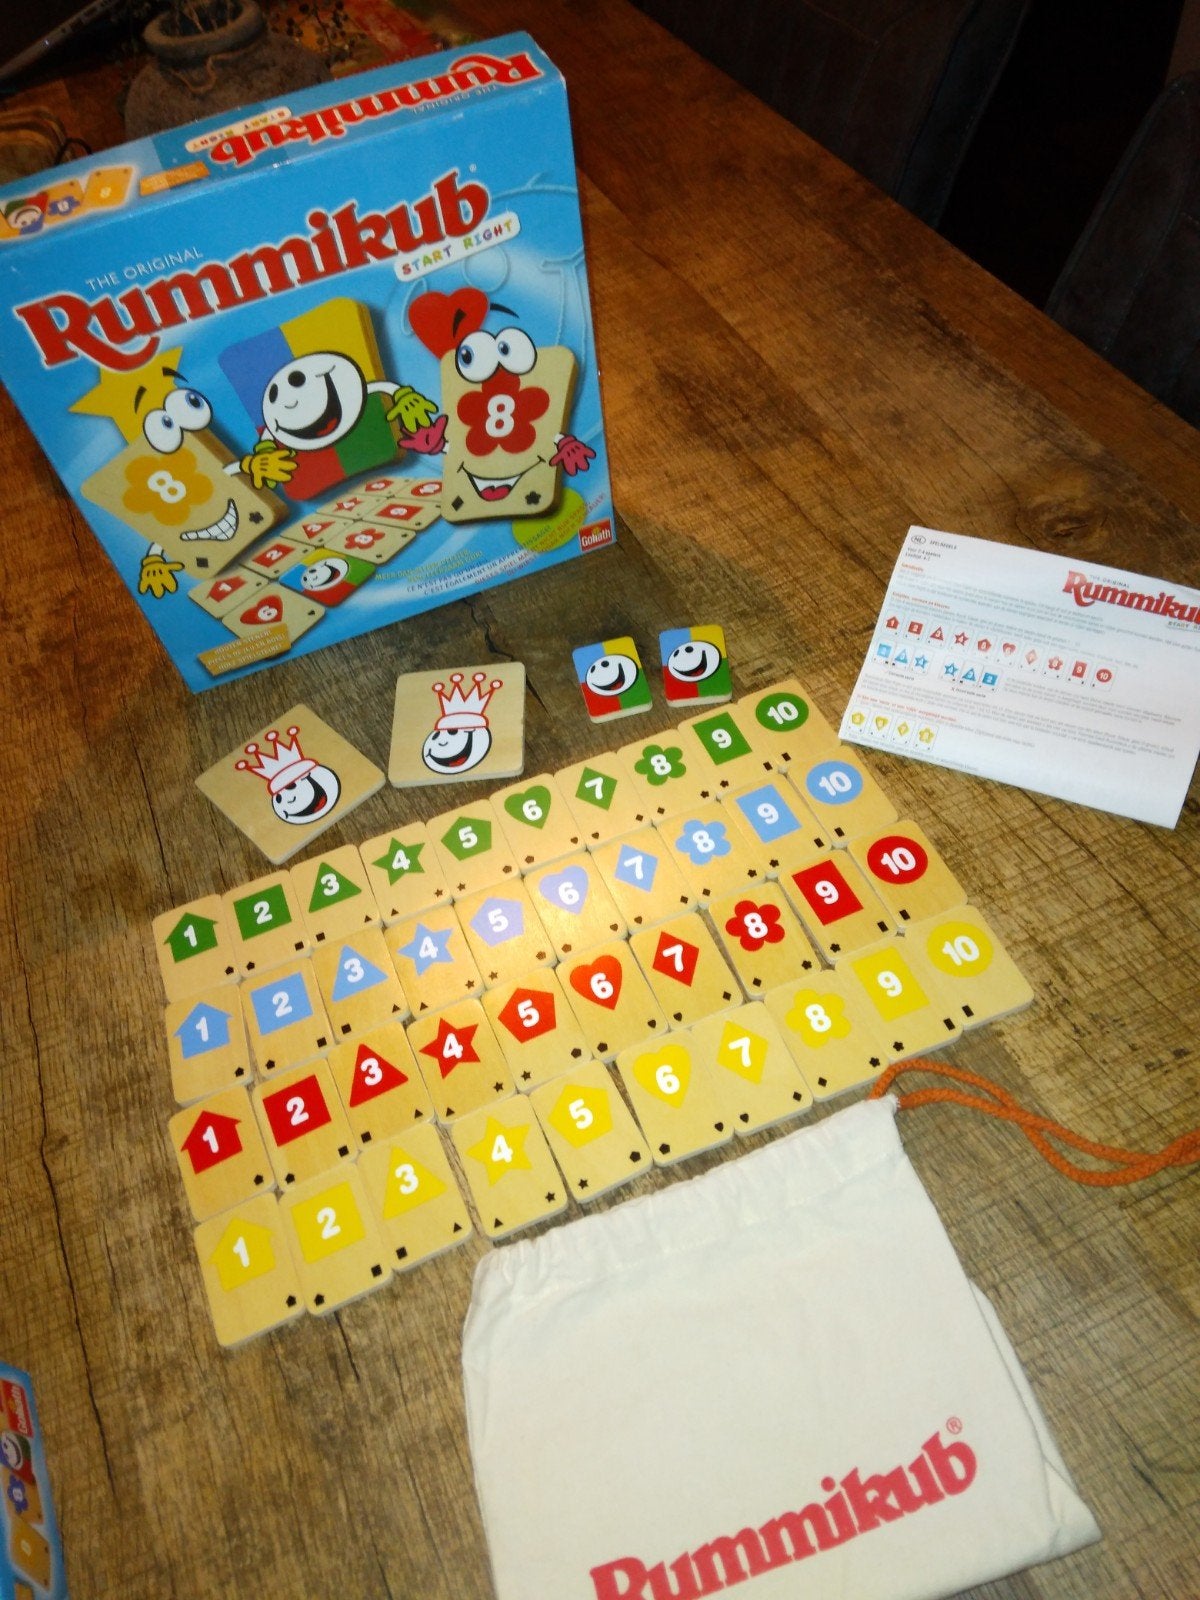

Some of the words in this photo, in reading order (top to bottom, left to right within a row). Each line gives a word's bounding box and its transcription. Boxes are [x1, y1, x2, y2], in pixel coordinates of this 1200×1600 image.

[210, 53, 544, 166] Rummikub
[402, 247, 453, 277] START
[462, 219, 514, 252] RIGHT
[16, 168, 491, 373] Rummikub
[85, 271, 121, 292] THE
[124, 246, 204, 280] ORIGINAL
[487, 394, 516, 438] 8
[147, 469, 187, 505] 8
[581, 527, 611, 547] Goliath
[767, 701, 799, 725] 10
[712, 728, 732, 749] 9
[651, 754, 672, 776] 8
[585, 777, 604, 799] 7
[819, 770, 852, 797] 10
[522, 800, 543, 821] 6
[757, 802, 779, 825] 9
[458, 826, 478, 848] 5
[692, 830, 715, 853] 8
[392, 850, 411, 870] 4
[624, 855, 644, 880] 7
[881, 847, 917, 876] 10
[320, 873, 340, 896] 3
[558, 882, 580, 905] 6
[815, 880, 839, 905] 9
[254, 901, 273, 925] 2
[488, 908, 509, 932] 5
[744, 912, 768, 939] 8
[184, 925, 198, 947] 1
[419, 936, 438, 959] 4
[662, 944, 684, 973] 7
[942, 935, 980, 966] 10
[343, 958, 365, 983] 3
[877, 971, 903, 997] 9
[590, 972, 614, 1000] 6
[272, 991, 293, 1017] 2
[517, 999, 540, 1028] 5
[196, 1017, 209, 1042] 1
[805, 1003, 832, 1033] 8
[443, 1034, 463, 1059] 4
[728, 1037, 751, 1068] 7
[360, 1058, 383, 1086] 3
[655, 1065, 680, 1095] 6
[286, 1096, 309, 1126] 2
[568, 1099, 594, 1130] 5
[203, 1126, 219, 1153] 1
[491, 1135, 513, 1163] 4
[395, 1164, 419, 1194] 3
[317, 1207, 341, 1239] 2
[233, 1237, 249, 1267] 1
[589, 1431, 978, 1600] Rummikub
